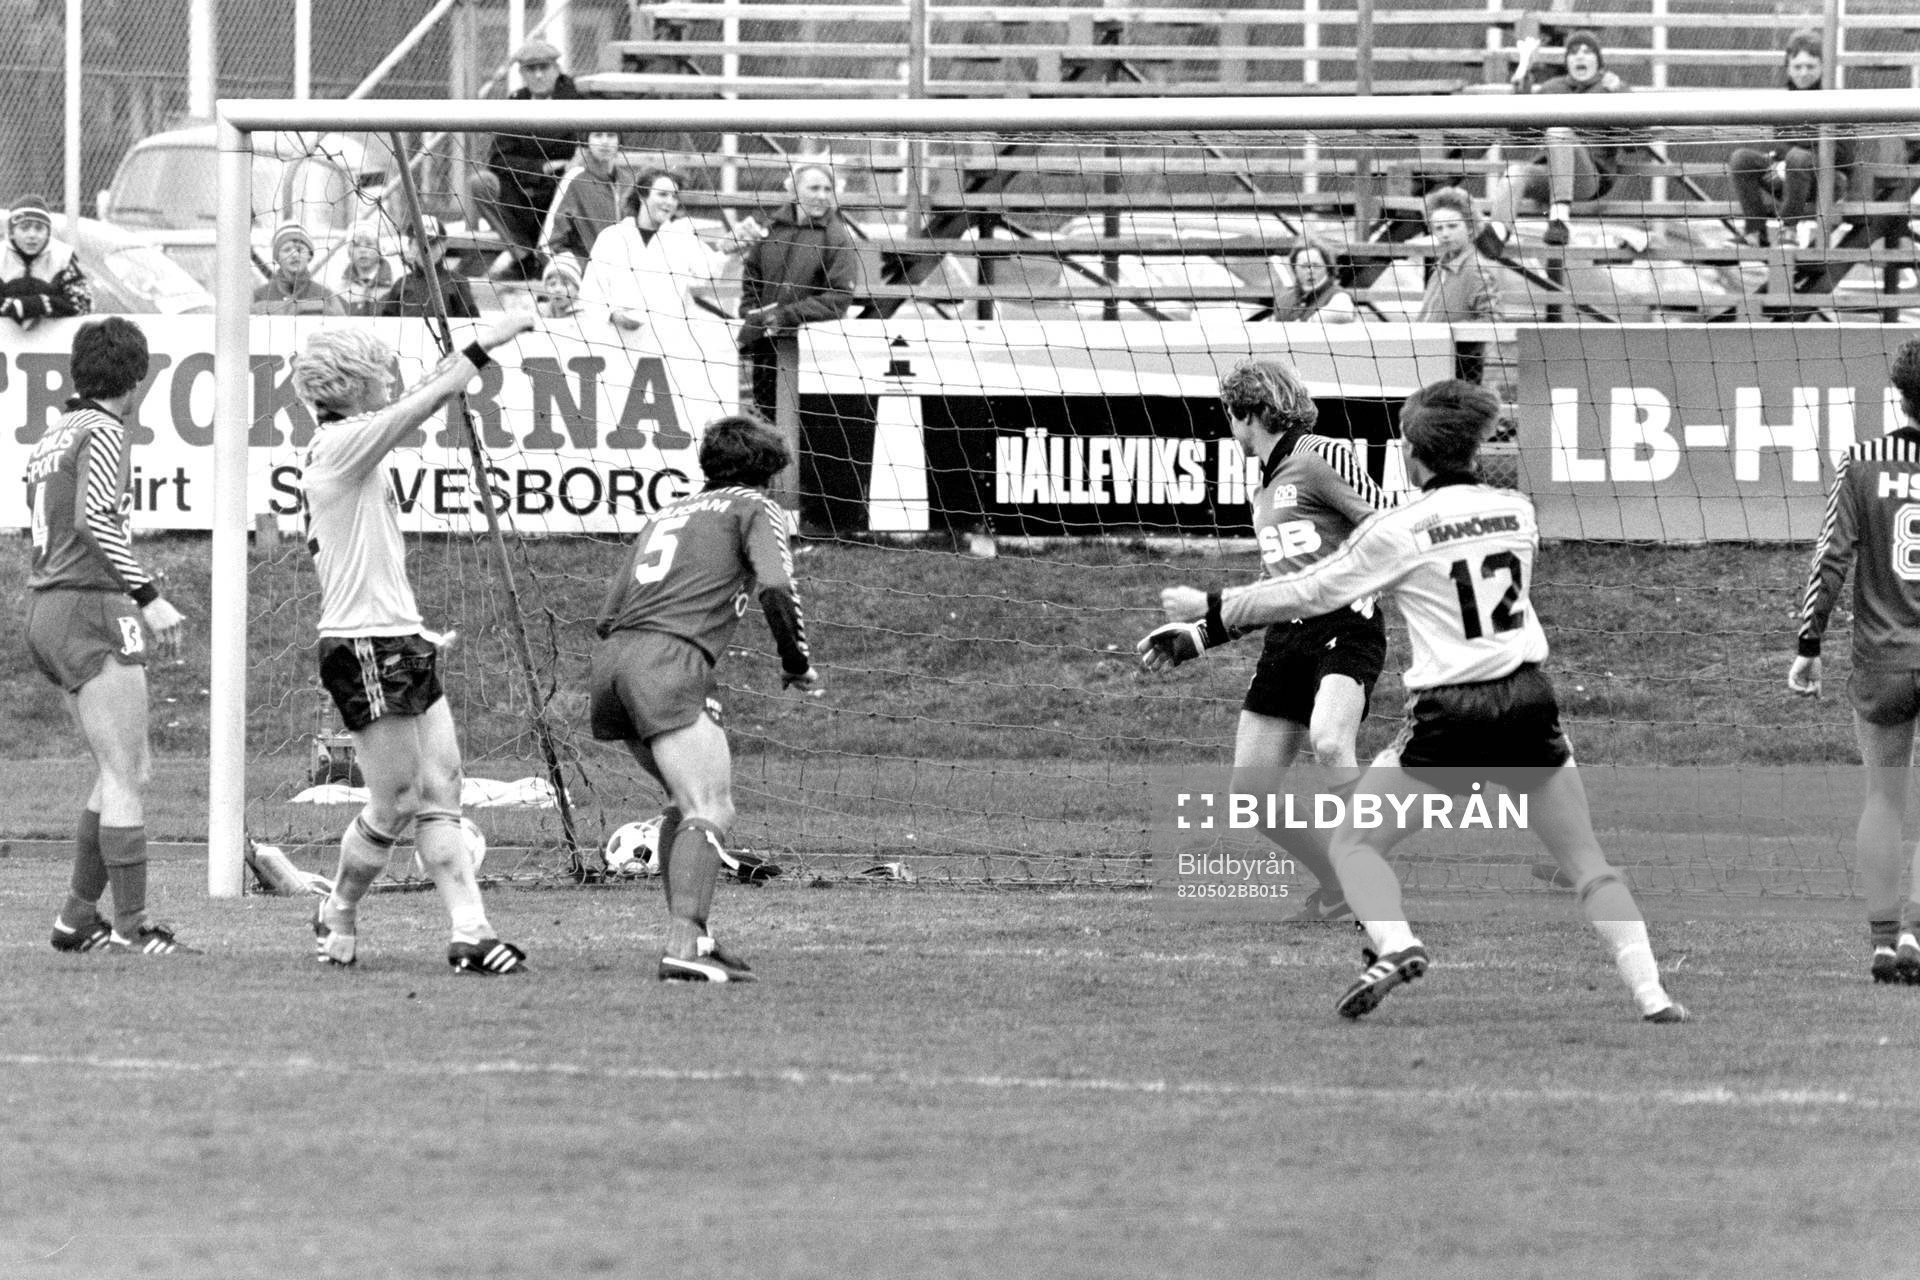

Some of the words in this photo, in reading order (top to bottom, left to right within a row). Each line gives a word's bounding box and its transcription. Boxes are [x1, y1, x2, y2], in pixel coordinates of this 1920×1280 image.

[0, 352, 692, 450] RYCKRNA
[1551, 387, 1908, 482] LB-HU
[269, 466, 690, 516] SVESBORG
[996, 427, 1206, 504] HÄLLEVIKS
[31, 481, 49, 555] 4
[635, 515, 690, 585] 5
[1259, 519, 1322, 564] SB
[1449, 551, 1525, 640] 12
